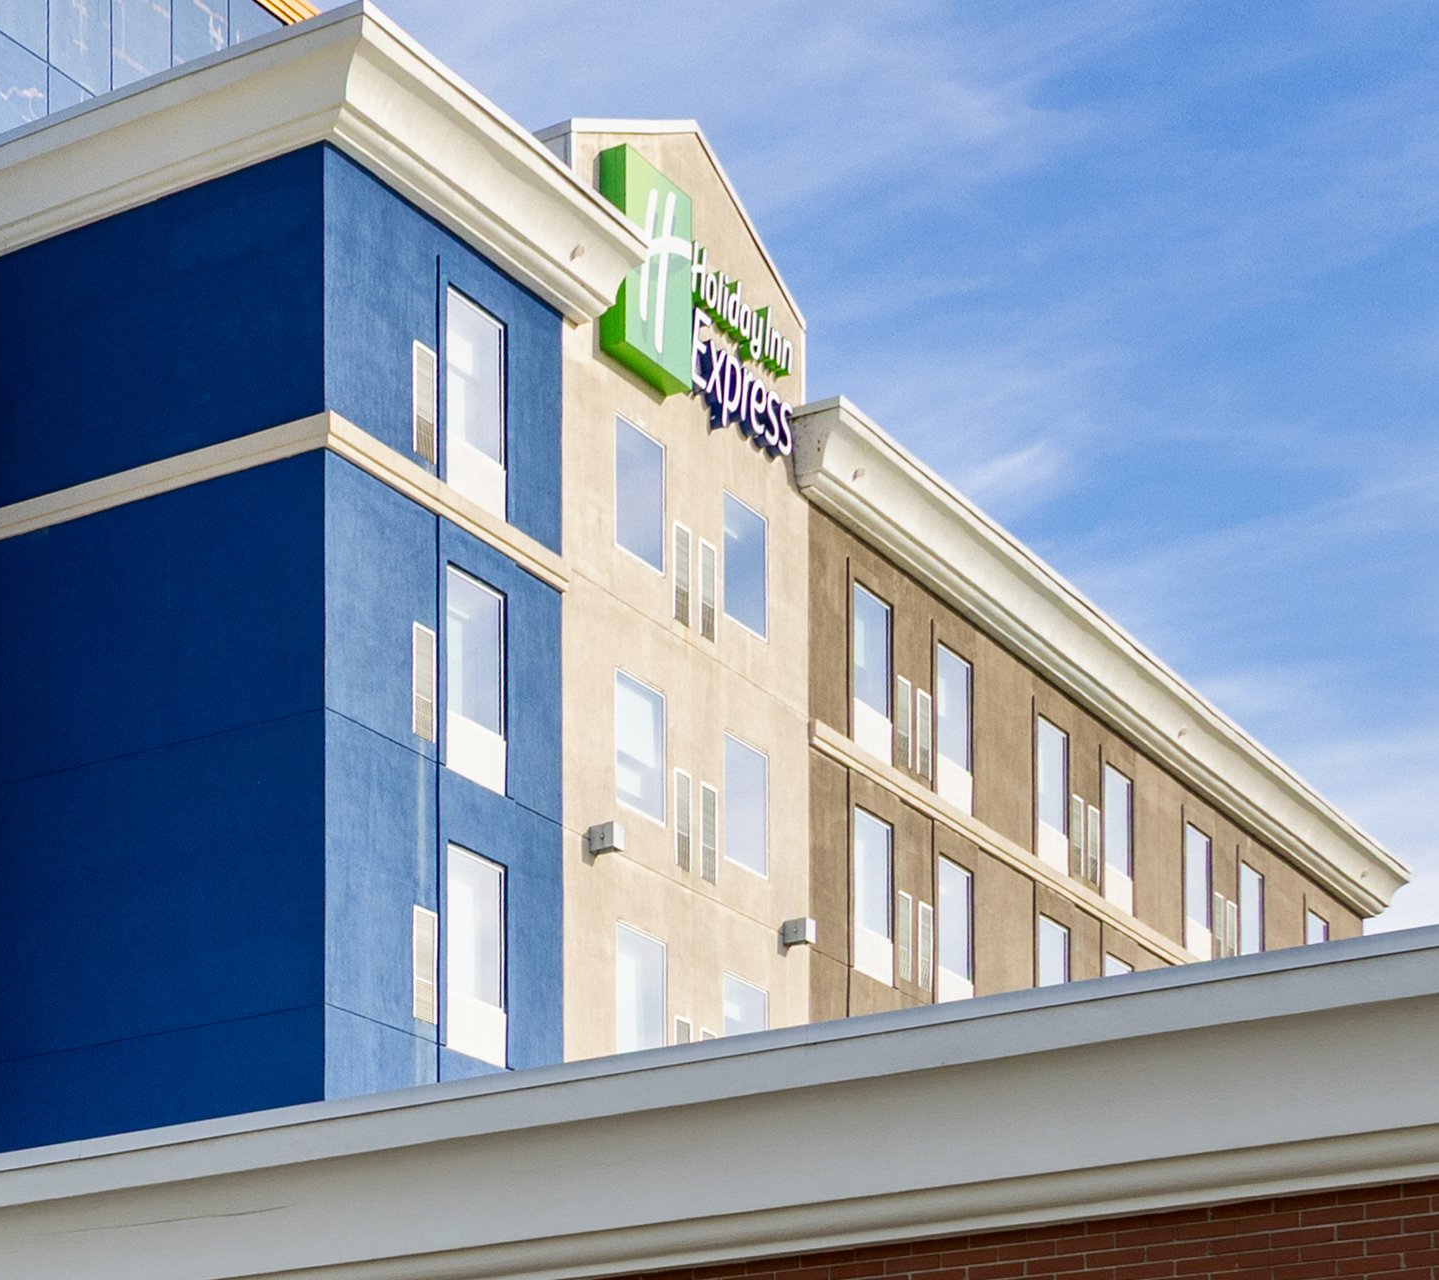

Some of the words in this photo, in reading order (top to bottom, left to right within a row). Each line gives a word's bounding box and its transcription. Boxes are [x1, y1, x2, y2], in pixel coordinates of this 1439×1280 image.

[691, 240, 763, 361] Holiday
[764, 307, 793, 374] Inn
[691, 307, 793, 457] Express
